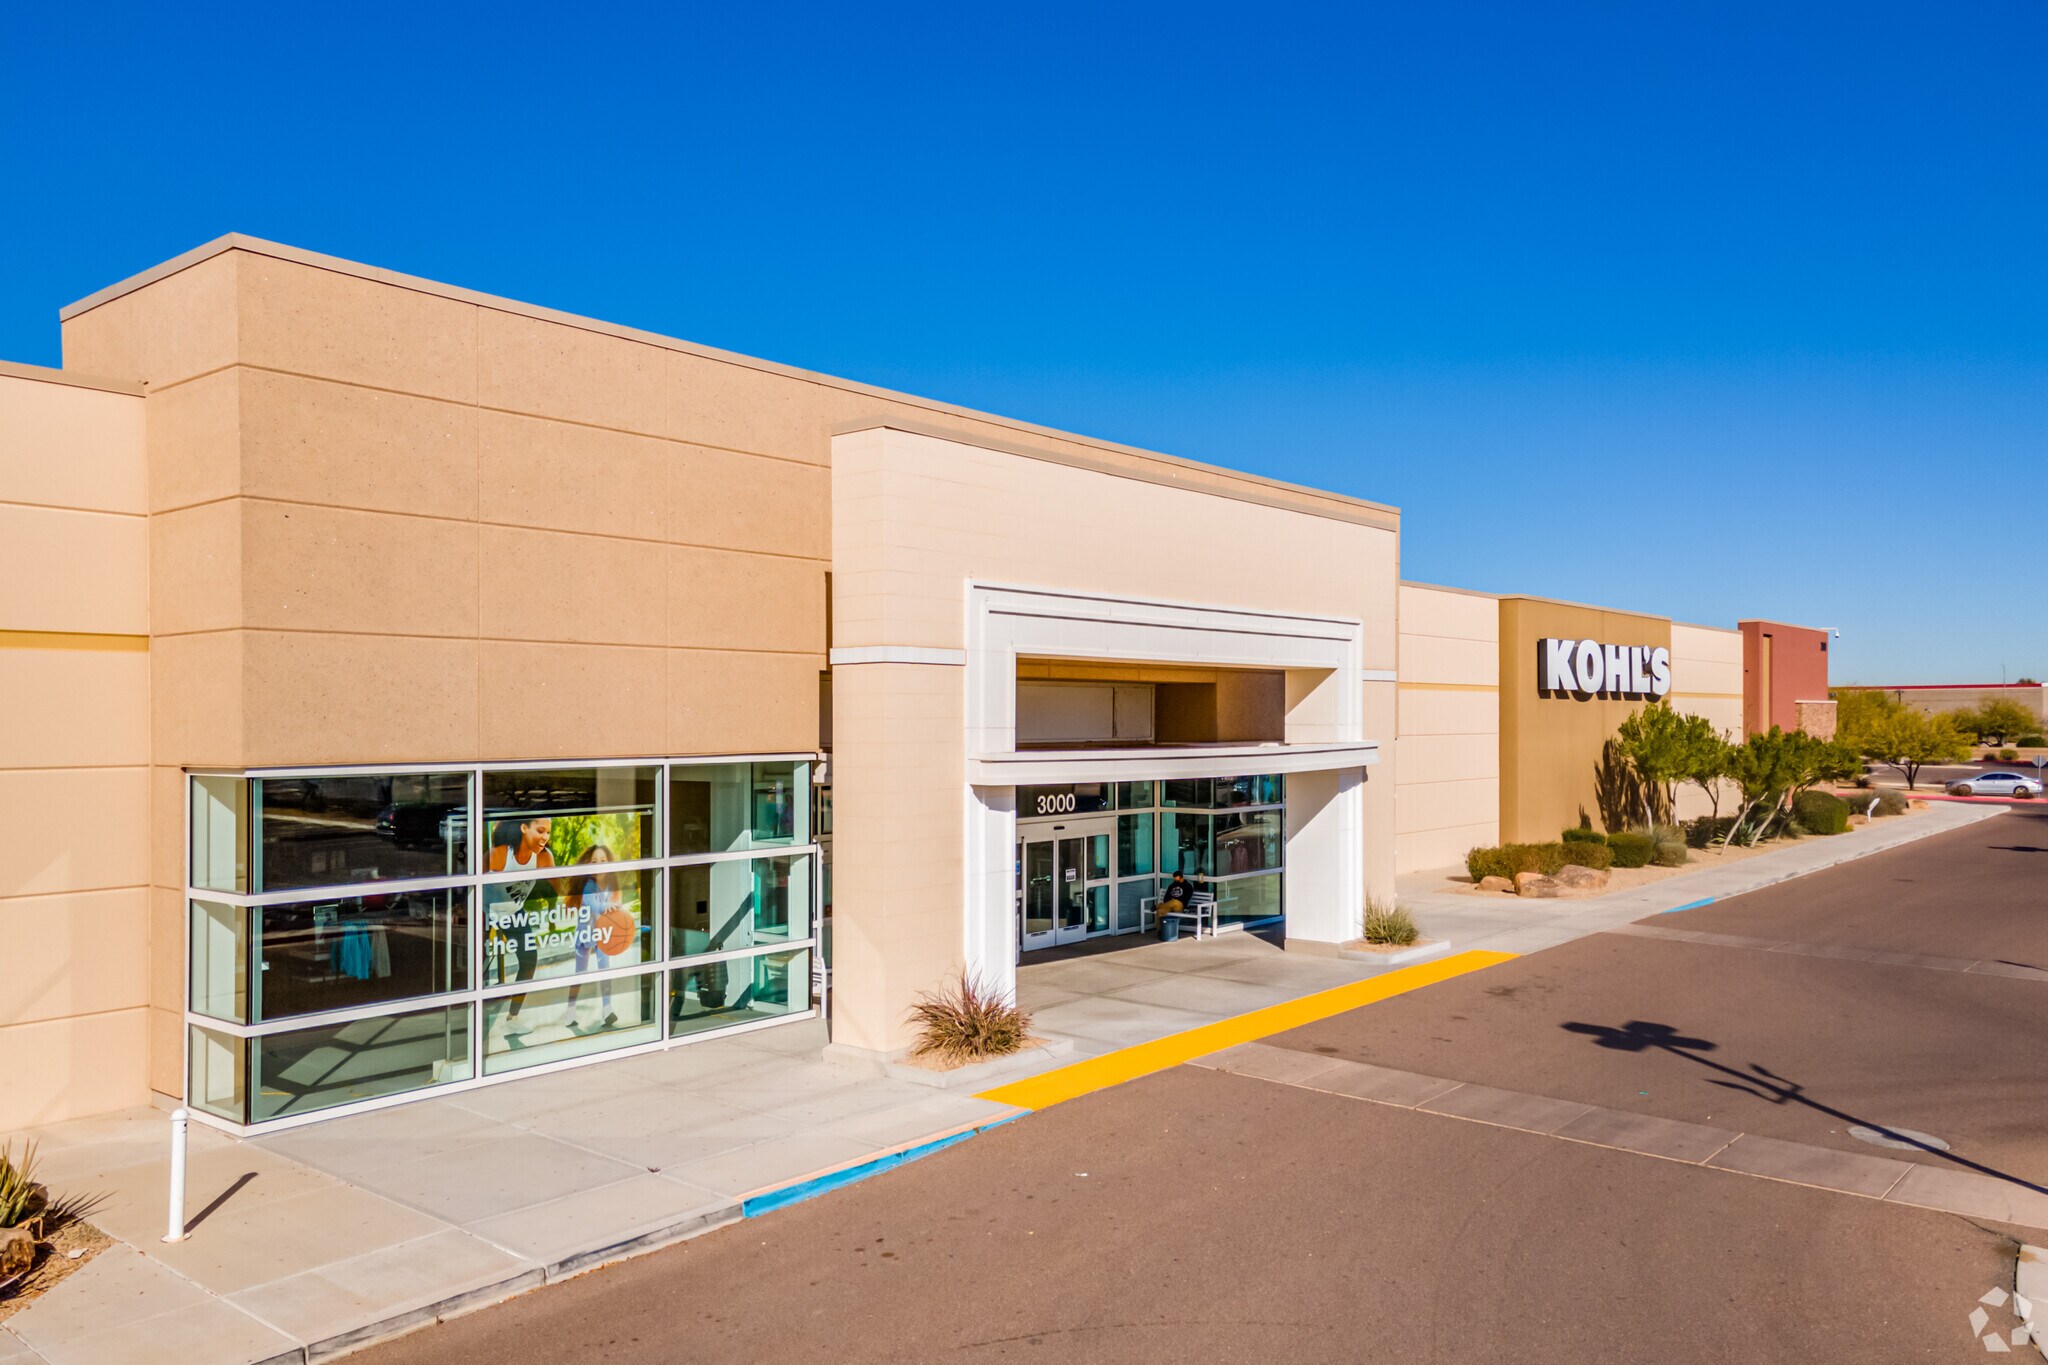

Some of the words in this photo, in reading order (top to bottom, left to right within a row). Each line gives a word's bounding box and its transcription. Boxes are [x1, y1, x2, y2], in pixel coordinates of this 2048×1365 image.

[1545, 638, 1671, 696] KOHL'S
[1037, 793, 1076, 814] 3000
[485, 903, 591, 931] Rewarding
[485, 936, 518, 956] the
[524, 925, 613, 951] Everyday
